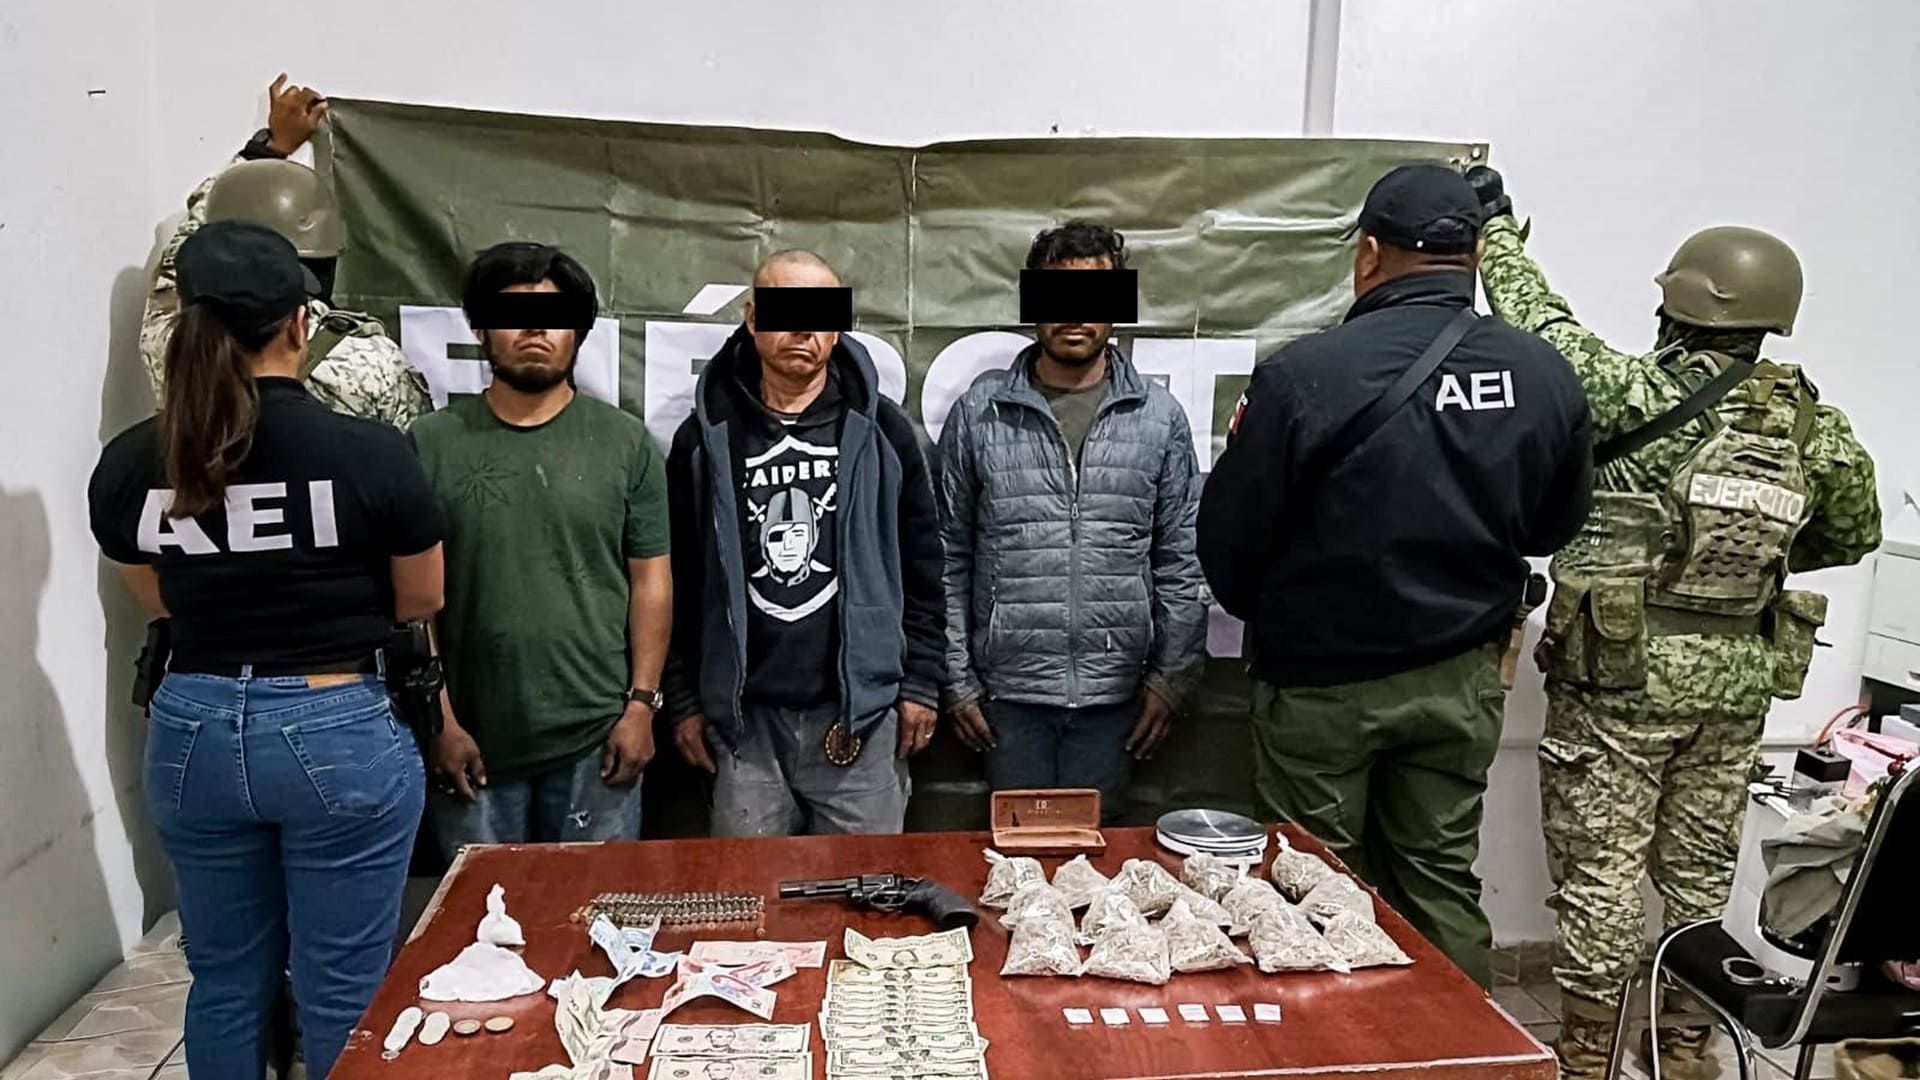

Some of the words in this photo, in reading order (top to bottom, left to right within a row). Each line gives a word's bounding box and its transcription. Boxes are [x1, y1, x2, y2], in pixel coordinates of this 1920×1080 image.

[1435, 370, 1515, 412] AEI
[743, 459, 839, 489] AIDER
[136, 479, 339, 556] AEI
